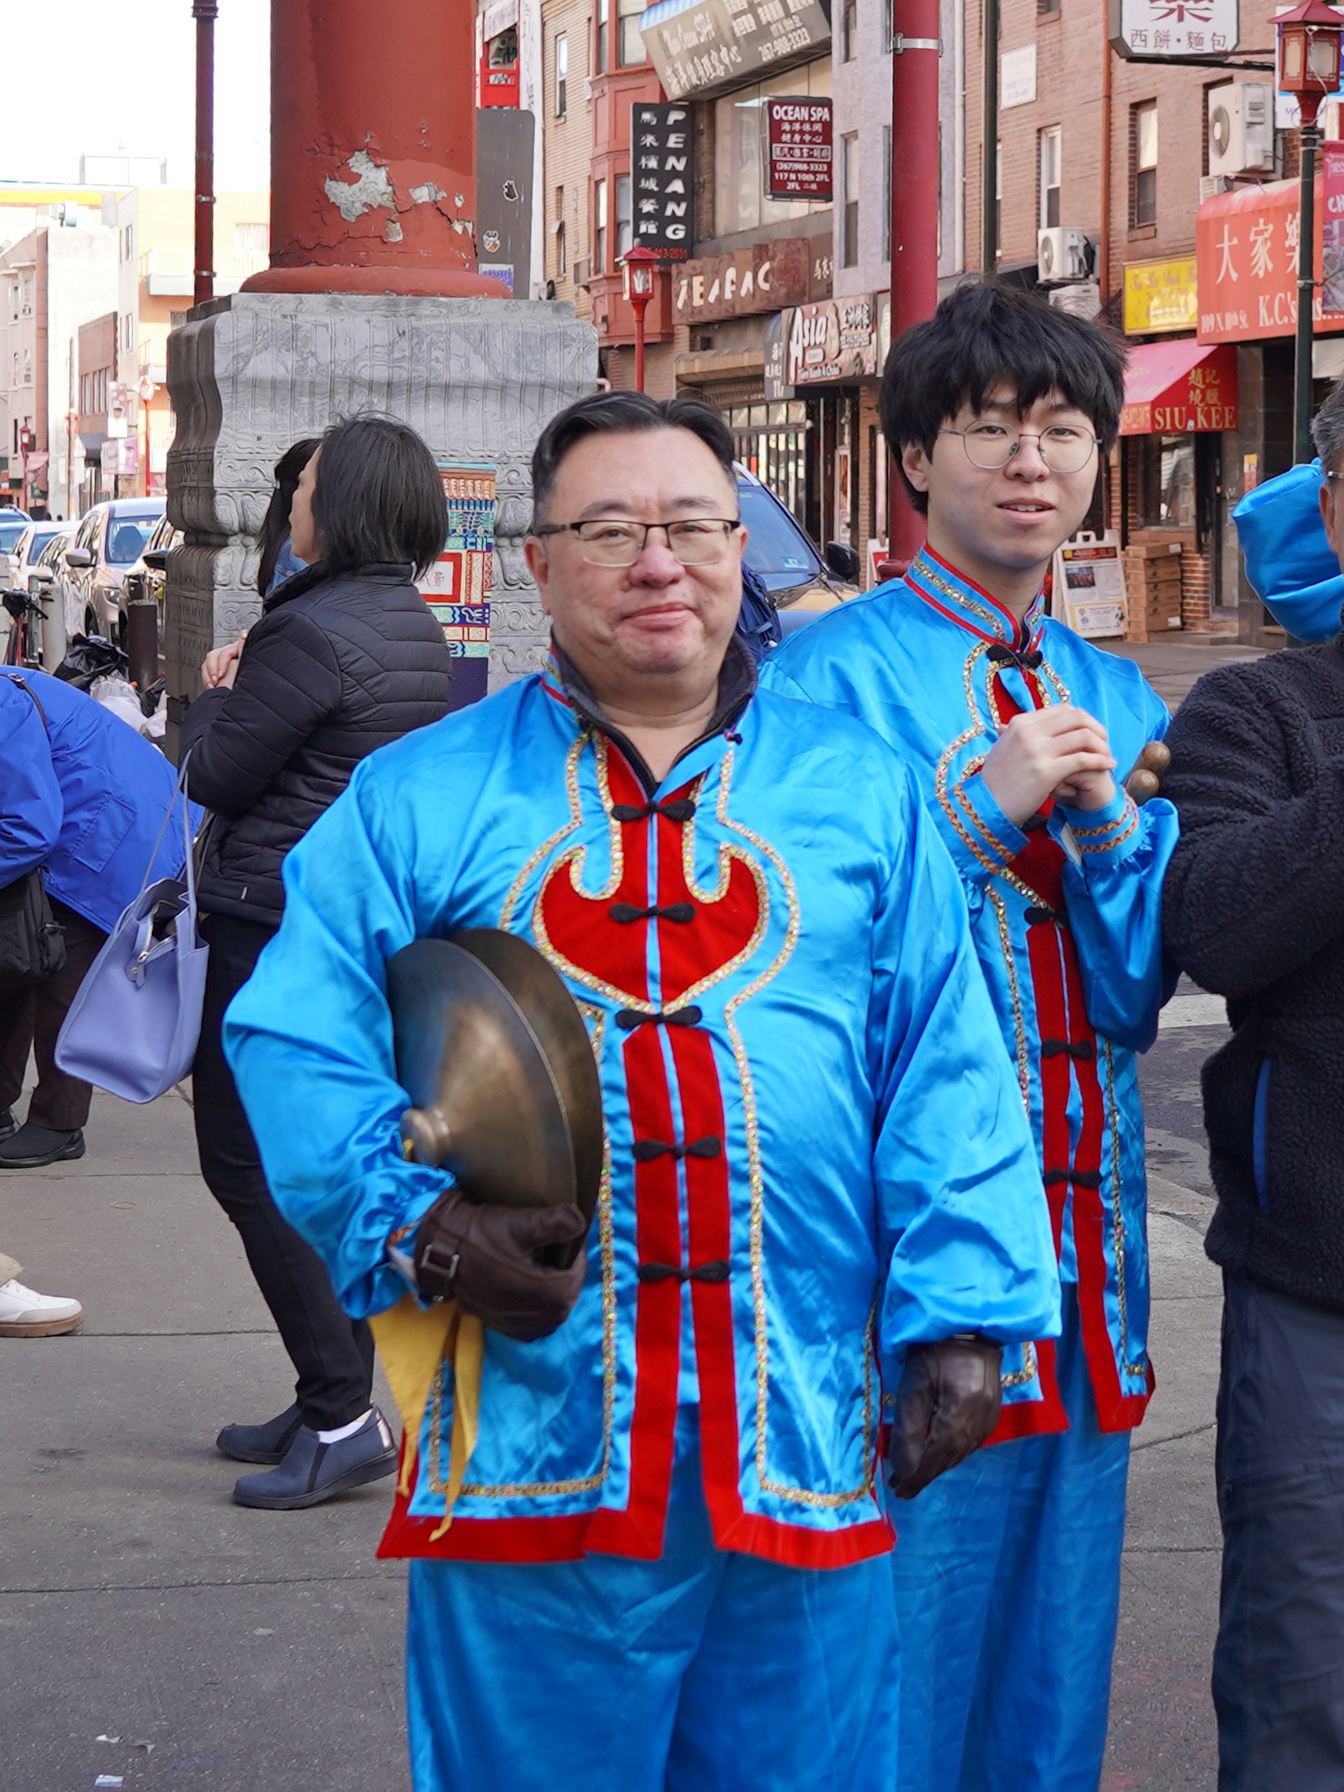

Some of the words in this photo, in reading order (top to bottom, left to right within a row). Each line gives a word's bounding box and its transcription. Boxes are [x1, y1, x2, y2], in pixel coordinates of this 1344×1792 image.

[772, 104, 809, 121] OCEAN
[810, 106, 830, 122] SPA
[664, 110, 687, 240] PENANG
[790, 306, 828, 384] Asia
[1154, 406, 1187, 431] SIU
[1195, 405, 1237, 430] KEE
